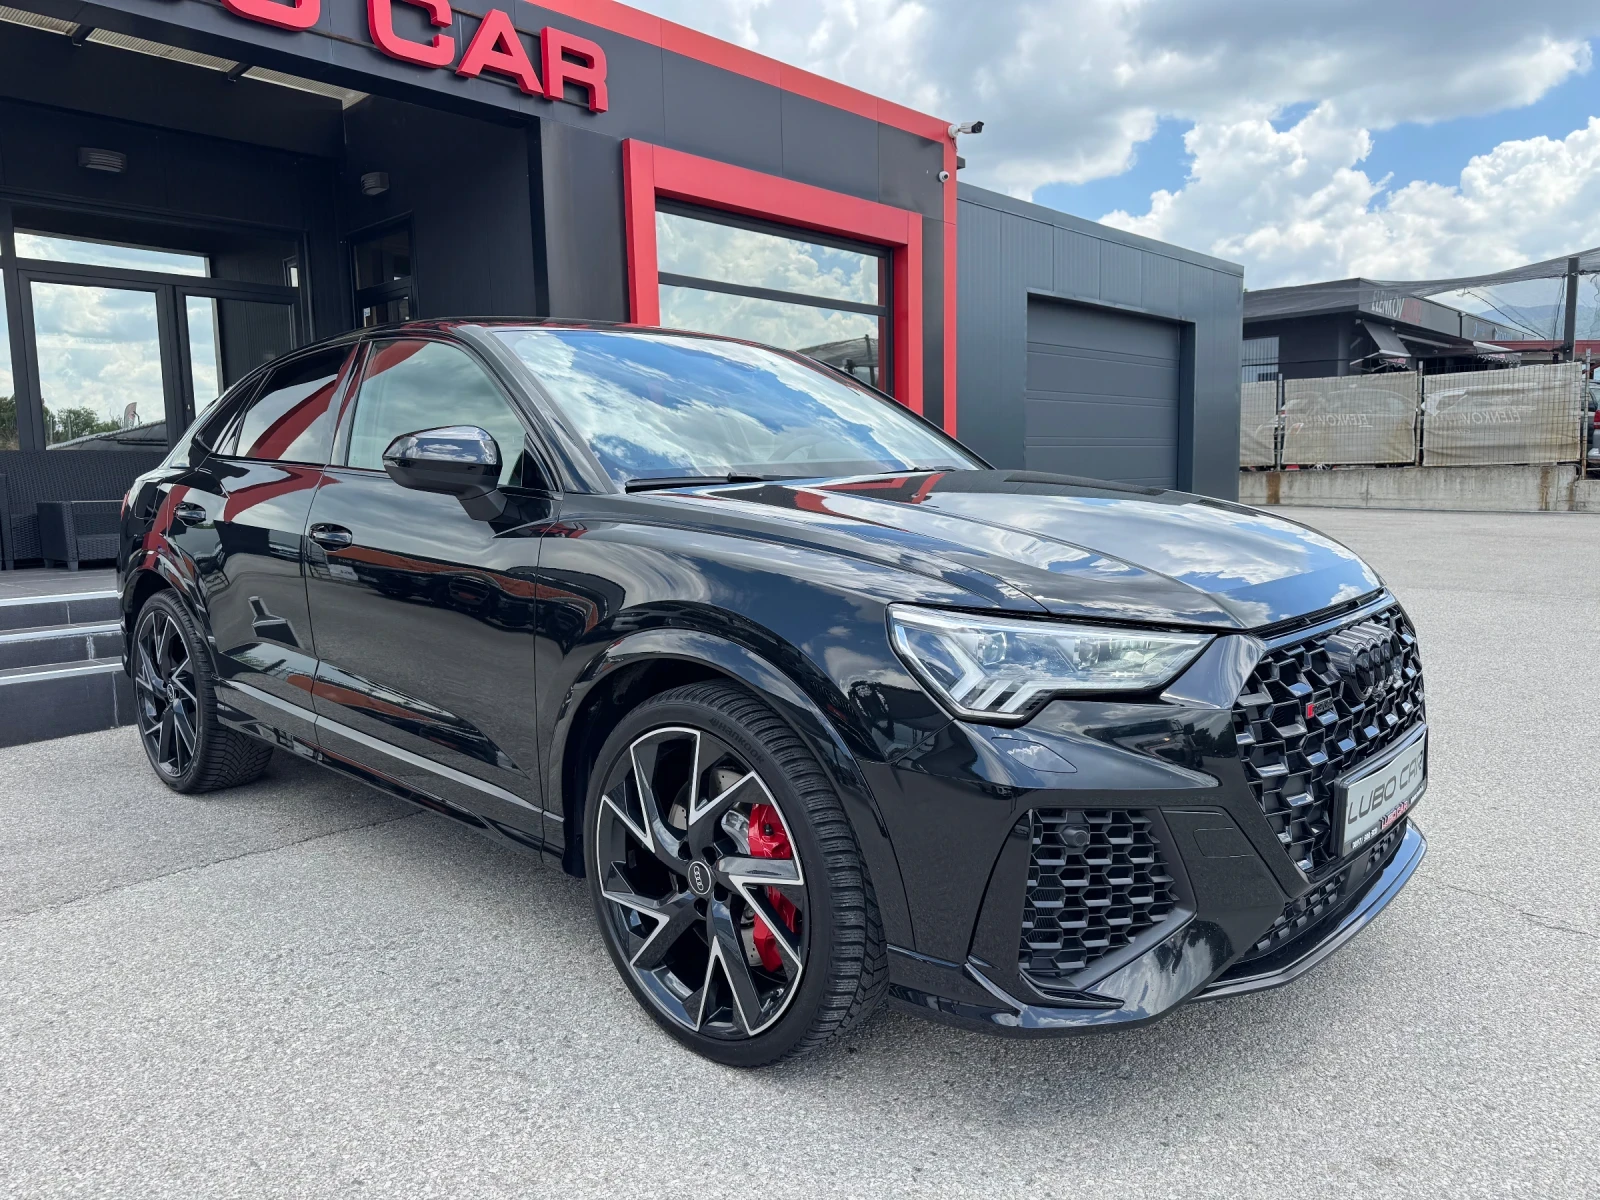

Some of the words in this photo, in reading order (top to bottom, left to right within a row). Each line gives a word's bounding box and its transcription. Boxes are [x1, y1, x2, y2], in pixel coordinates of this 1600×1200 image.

[367, 0, 609, 114] CAR
[1347, 775, 1397, 825] LUBO
[1399, 749, 1424, 790] CAR
